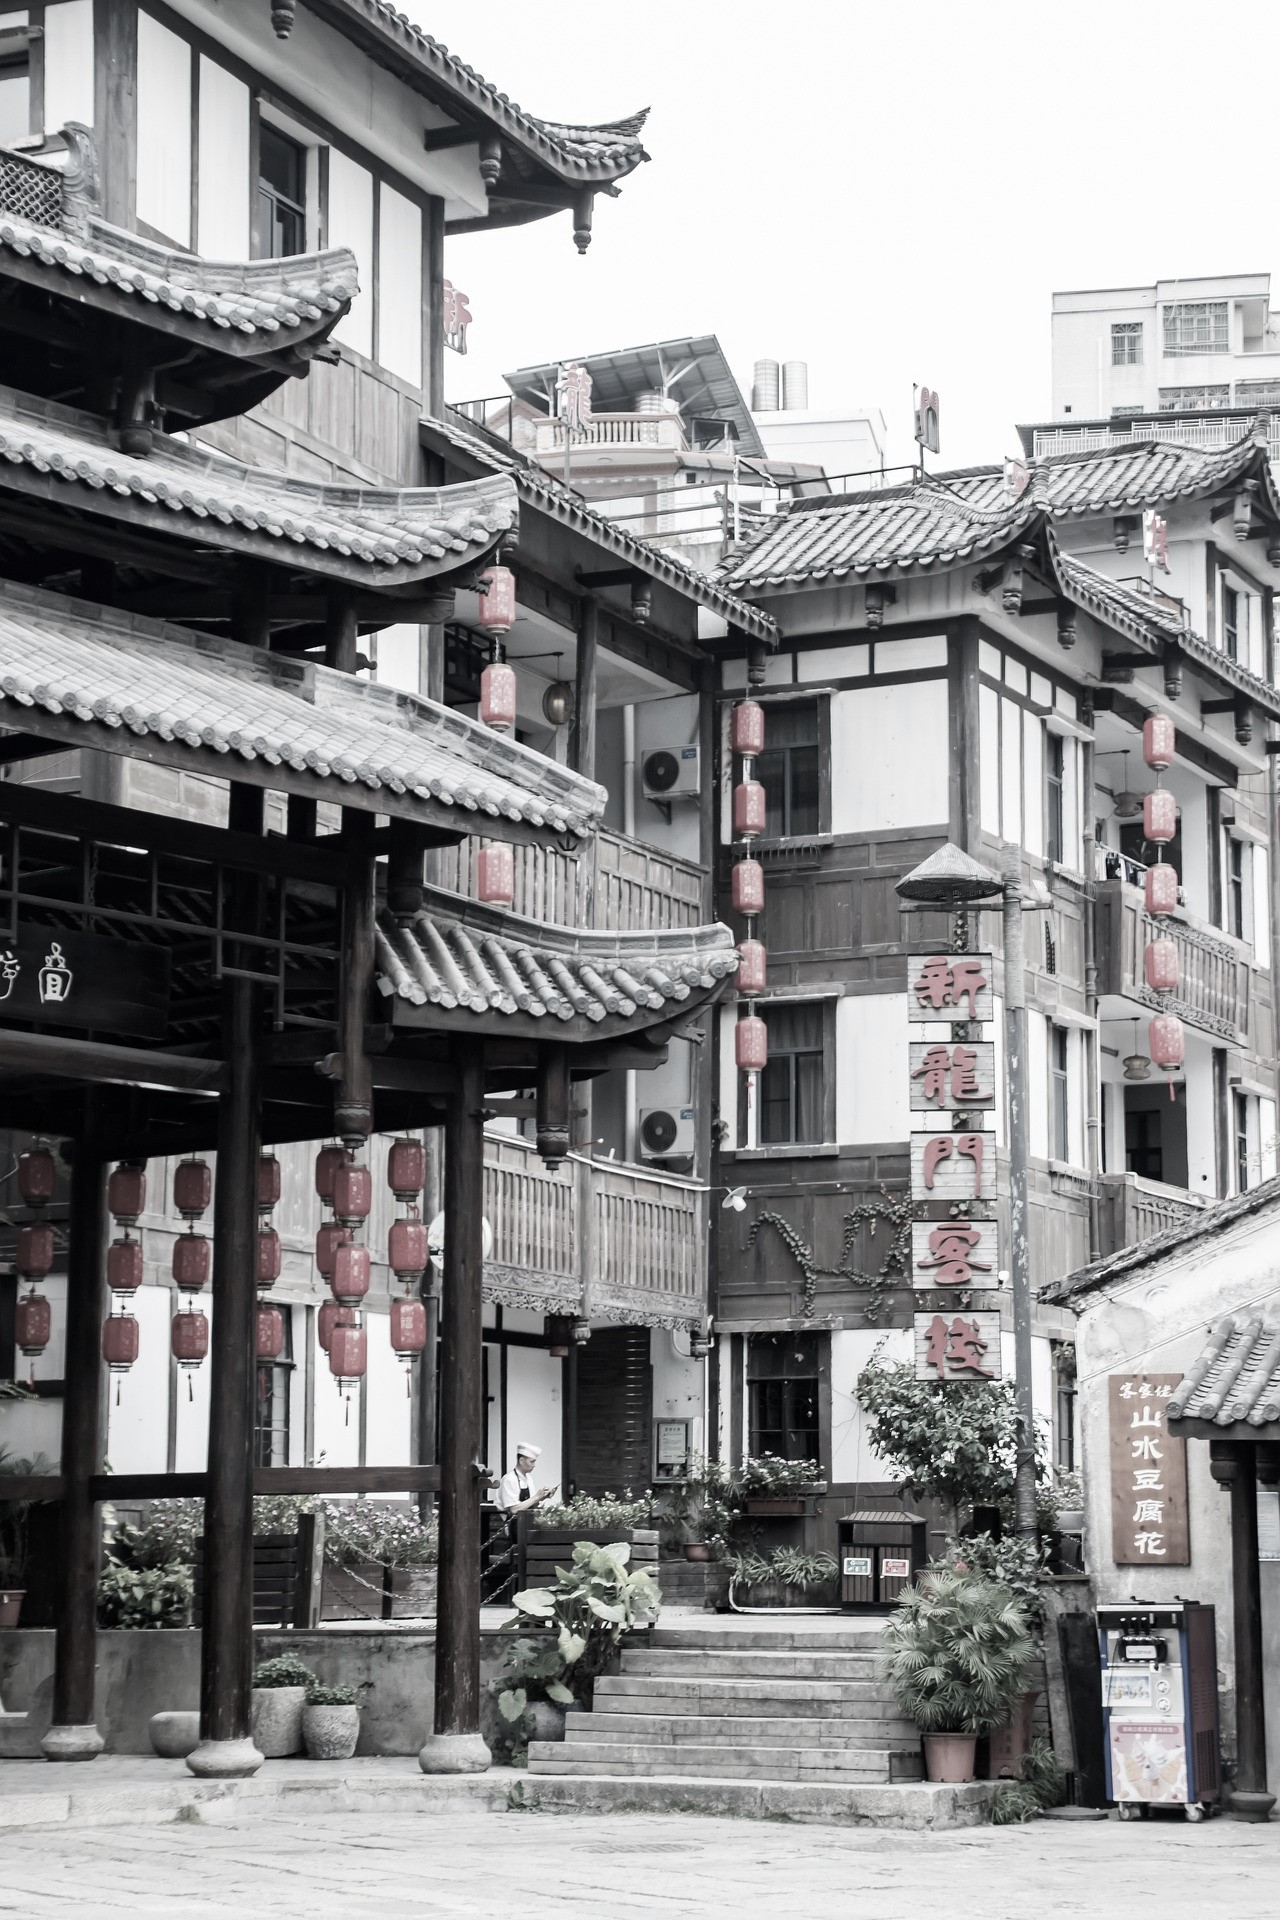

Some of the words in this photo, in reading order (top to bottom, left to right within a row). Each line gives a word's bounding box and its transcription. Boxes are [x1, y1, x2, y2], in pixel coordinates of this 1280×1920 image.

[1119, 1382, 1173, 1399] 客家佬
[1130, 1405, 1167, 1555] 山水豆腐花
